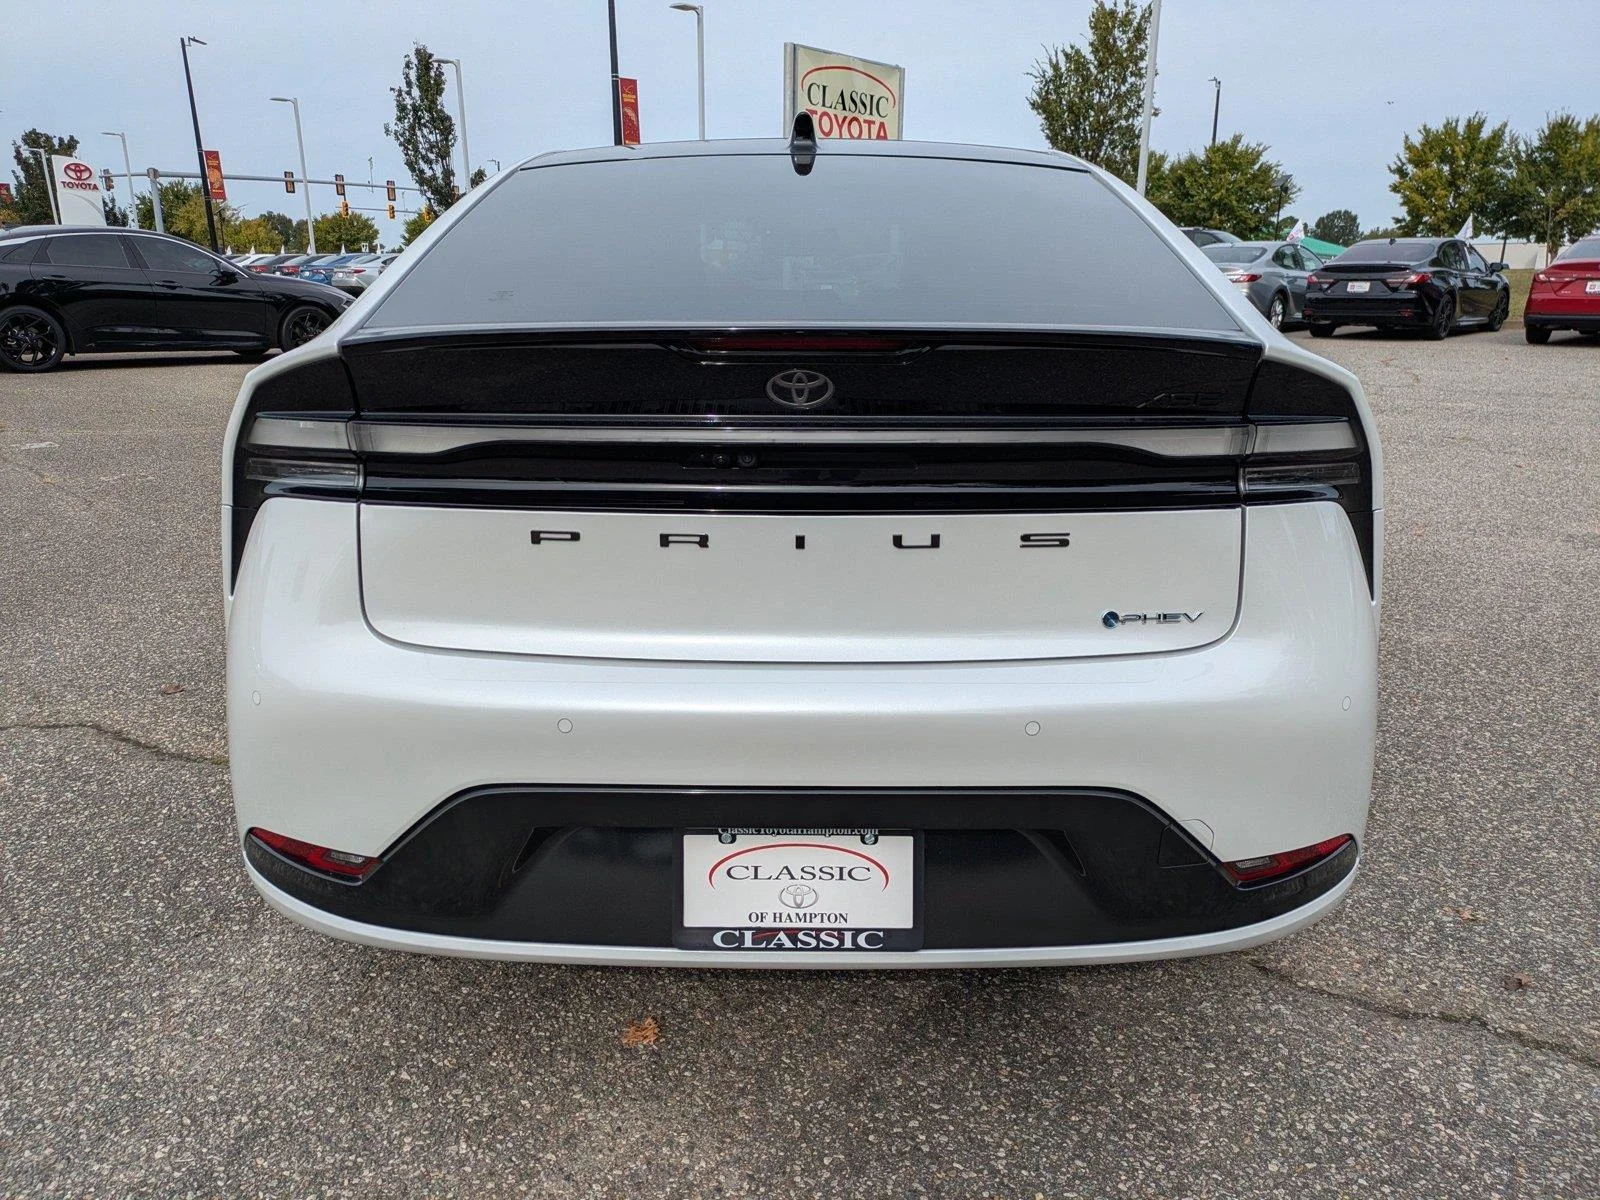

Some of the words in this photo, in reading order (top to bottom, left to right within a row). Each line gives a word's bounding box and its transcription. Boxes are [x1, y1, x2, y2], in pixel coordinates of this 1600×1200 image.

[807, 82, 889, 118] CLASSIC
[61, 181, 99, 191] TOYOTA
[530, 529, 1071, 550] PRIUS
[1119, 612, 1204, 625] PHEV
[726, 865, 871, 882] CLASSIC
[748, 912, 768, 924] OF
[772, 912, 849, 924] HAMPTON
[712, 930, 884, 949] CLASSIC
